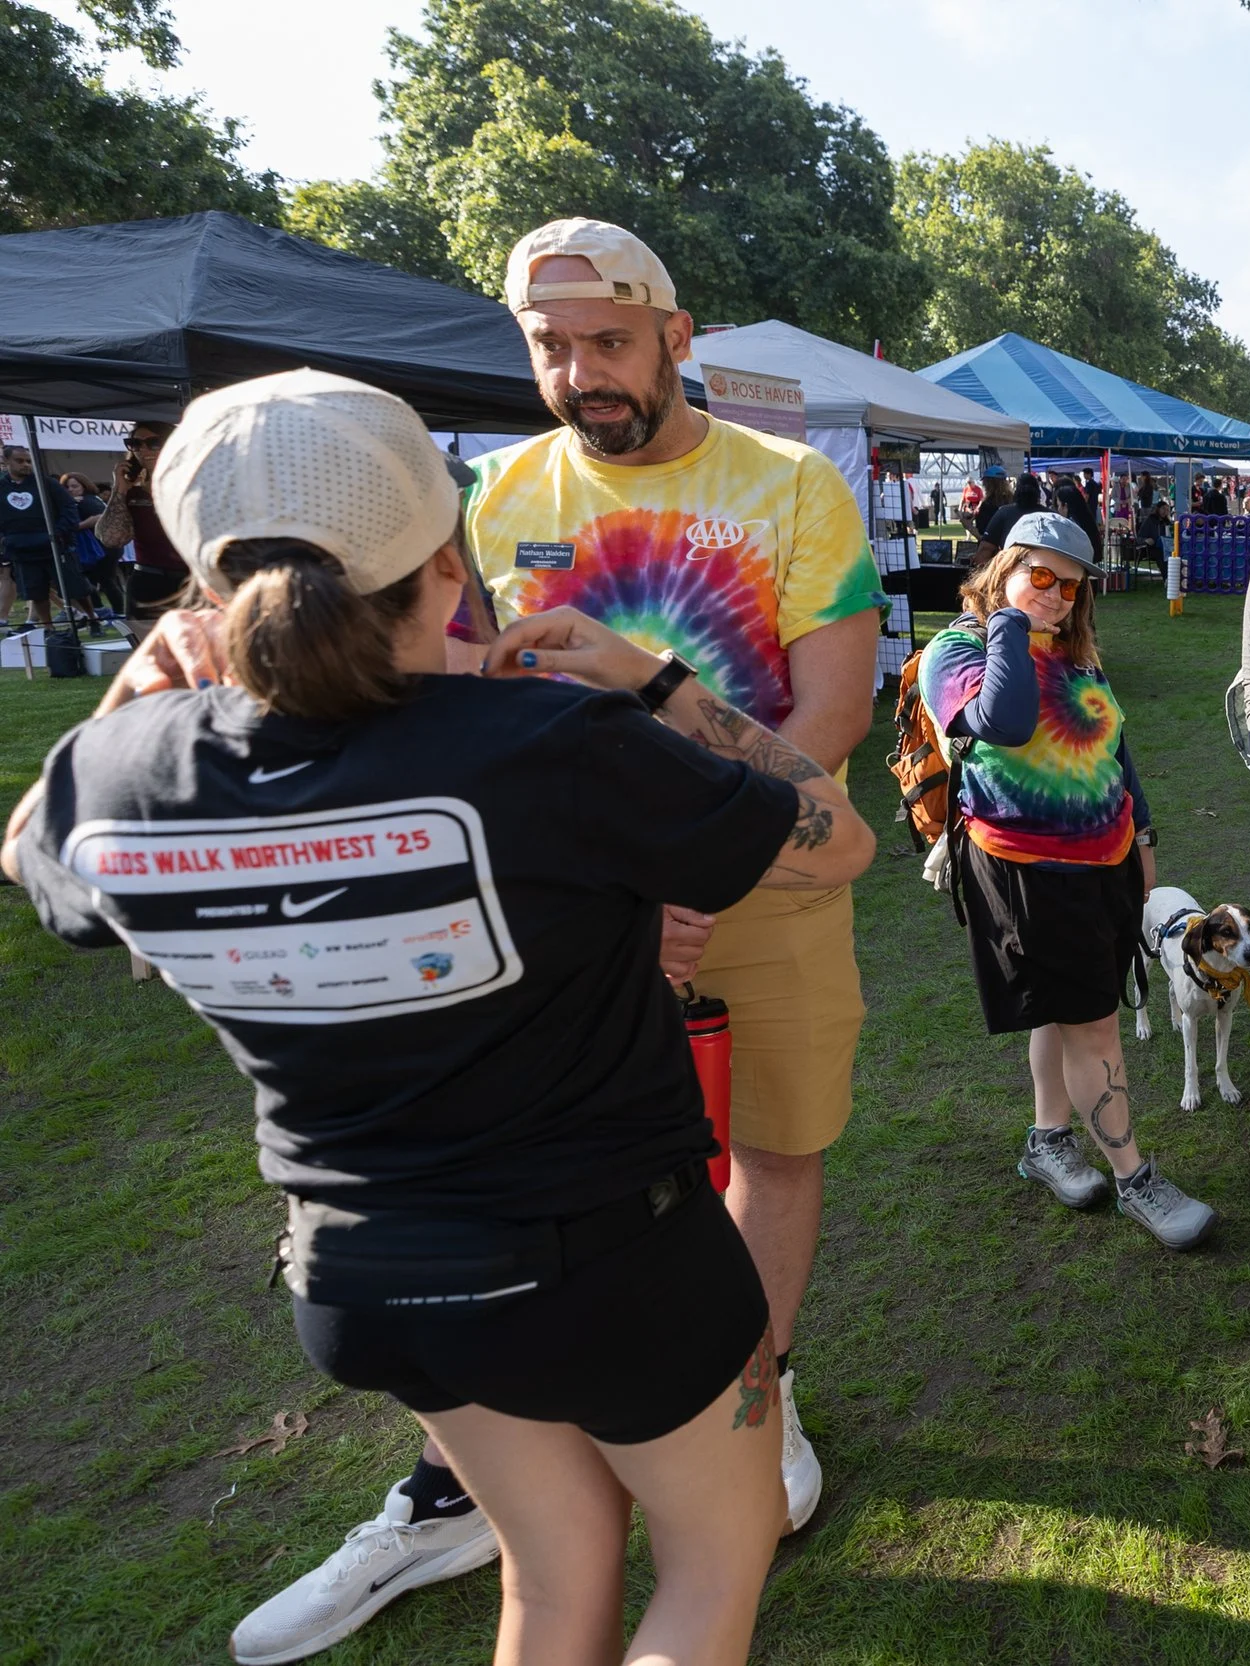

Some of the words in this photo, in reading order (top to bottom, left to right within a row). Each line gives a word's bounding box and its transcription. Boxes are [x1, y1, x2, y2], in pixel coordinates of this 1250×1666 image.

[730, 381, 762, 400] ROSE
[764, 386, 802, 405] HAVEN
[1193, 439, 1207, 447] NW
[1209, 440, 1240, 449] Natural
[691, 519, 738, 548] AAA
[97, 851, 149, 876] AIDS
[153, 848, 225, 875] WALK
[229, 833, 377, 871] NORTHWEST
